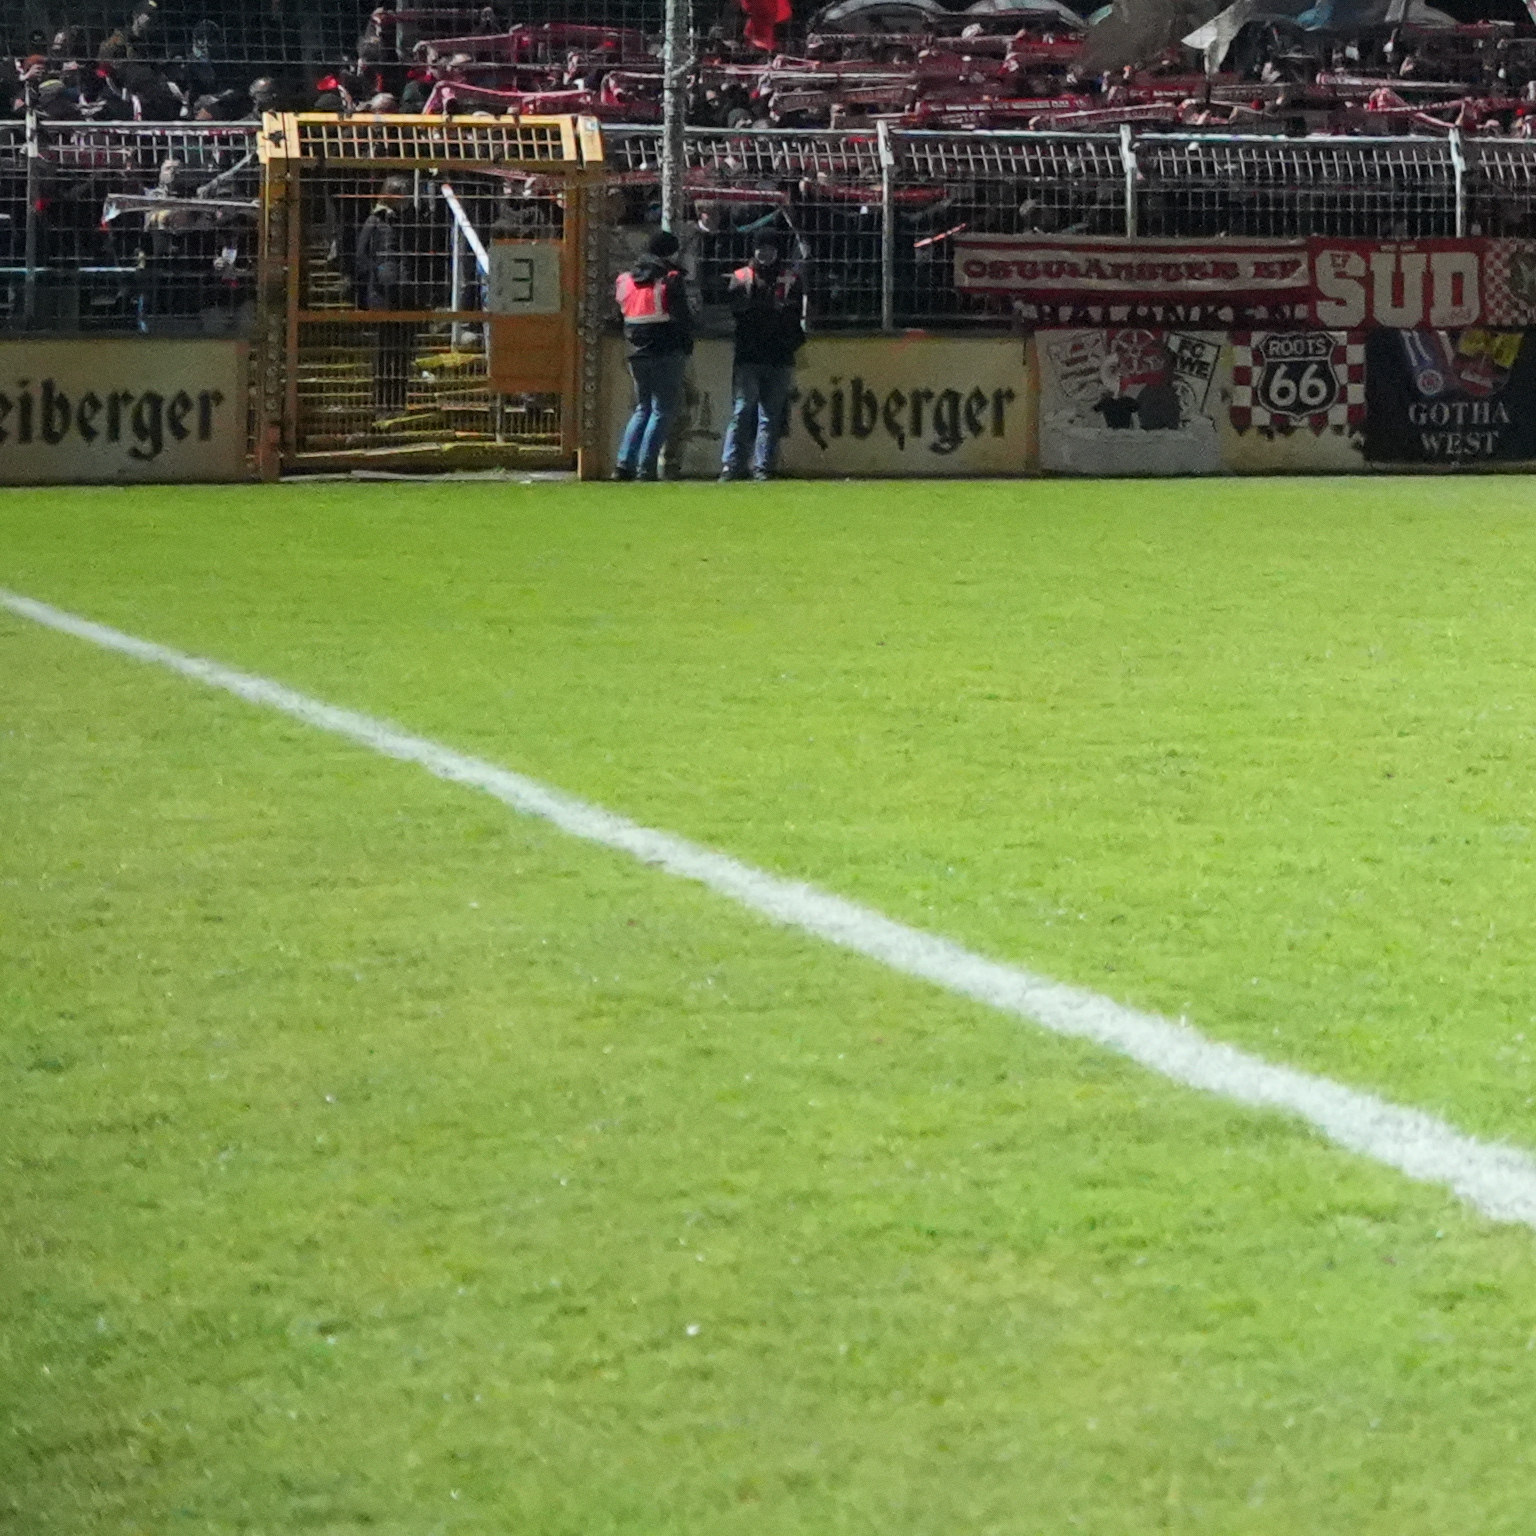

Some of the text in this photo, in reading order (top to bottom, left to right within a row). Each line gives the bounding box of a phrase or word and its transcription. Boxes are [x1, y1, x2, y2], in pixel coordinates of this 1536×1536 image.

[513, 258, 533, 301] 3
[1315, 242, 1480, 328] SÜD
[1268, 339, 1327, 357] ROOTS
[1178, 356, 1211, 378] WE
[1269, 365, 1327, 406] 66
[1409, 402, 1510, 425] GOTHA
[1421, 432, 1498, 455] WEST
